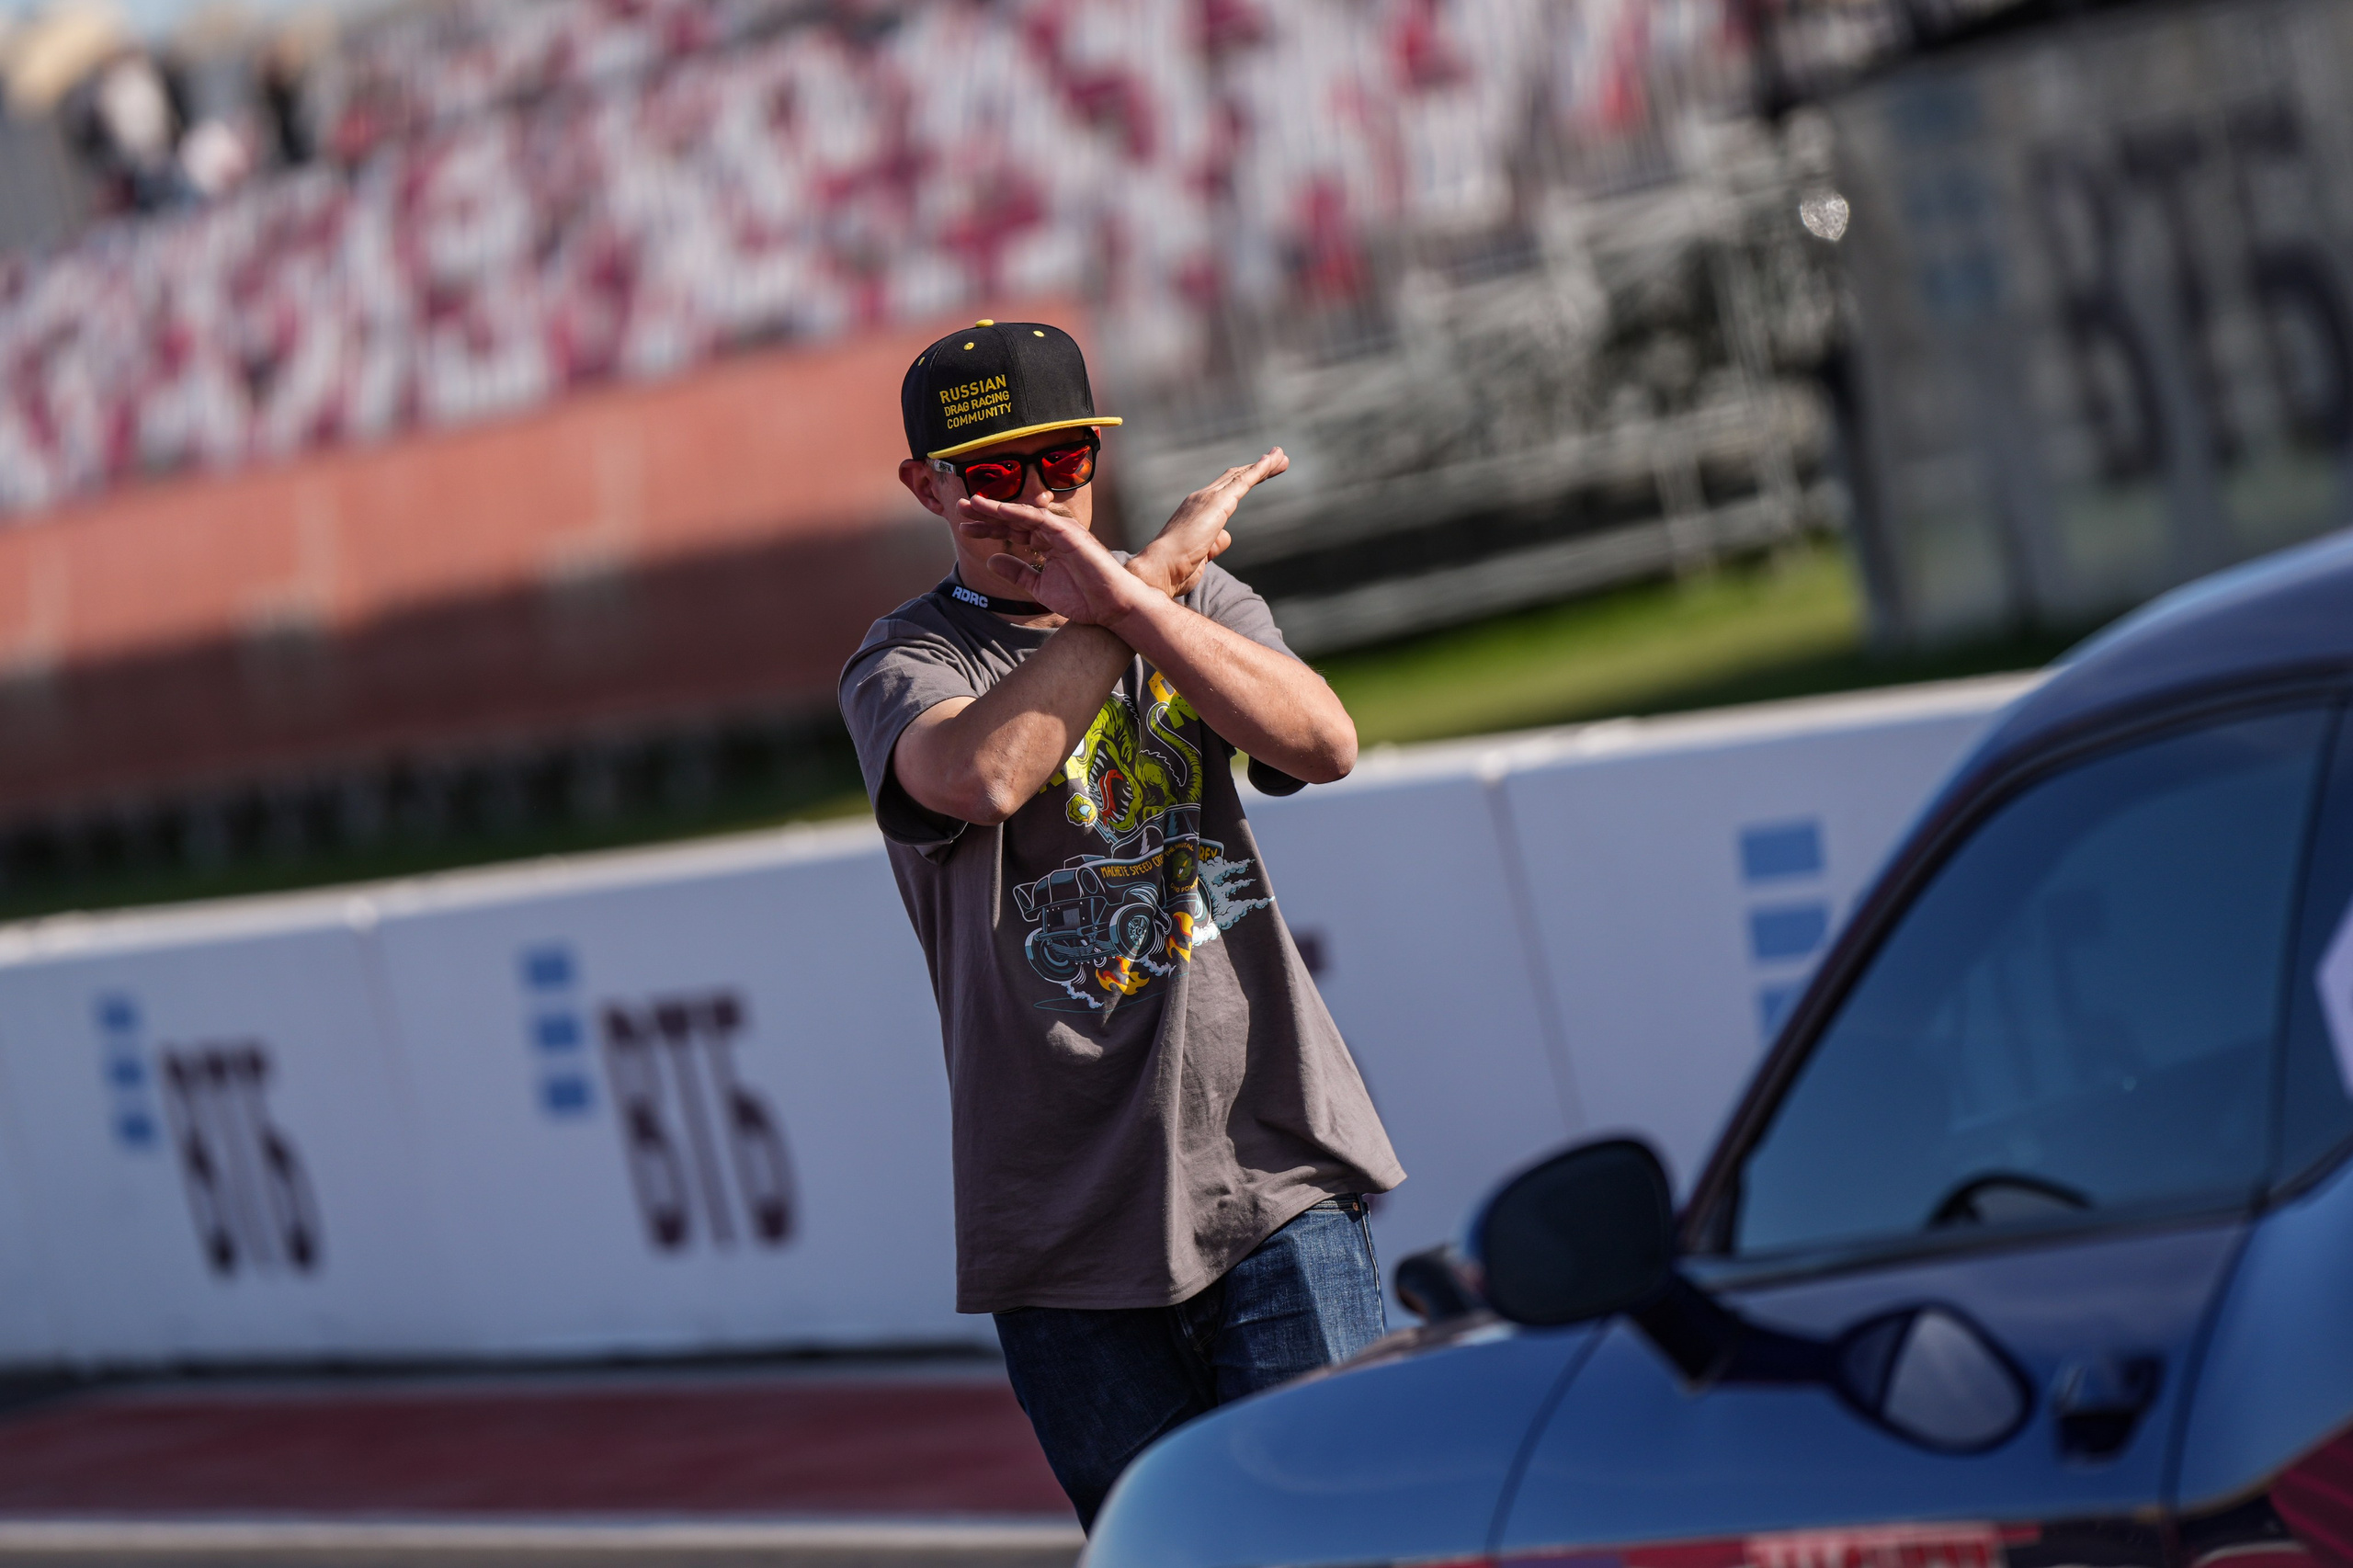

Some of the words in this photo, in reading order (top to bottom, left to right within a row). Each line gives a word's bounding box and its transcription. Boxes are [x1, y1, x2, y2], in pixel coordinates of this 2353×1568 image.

[939, 374, 1007, 404] RUSSIAN
[944, 401, 970, 417] DRAG
[971, 390, 1010, 410] RACING
[947, 402, 1012, 429] COMMUNITY
[1100, 865, 1131, 879] MACHETE
[1129, 860, 1154, 877] SPEED
